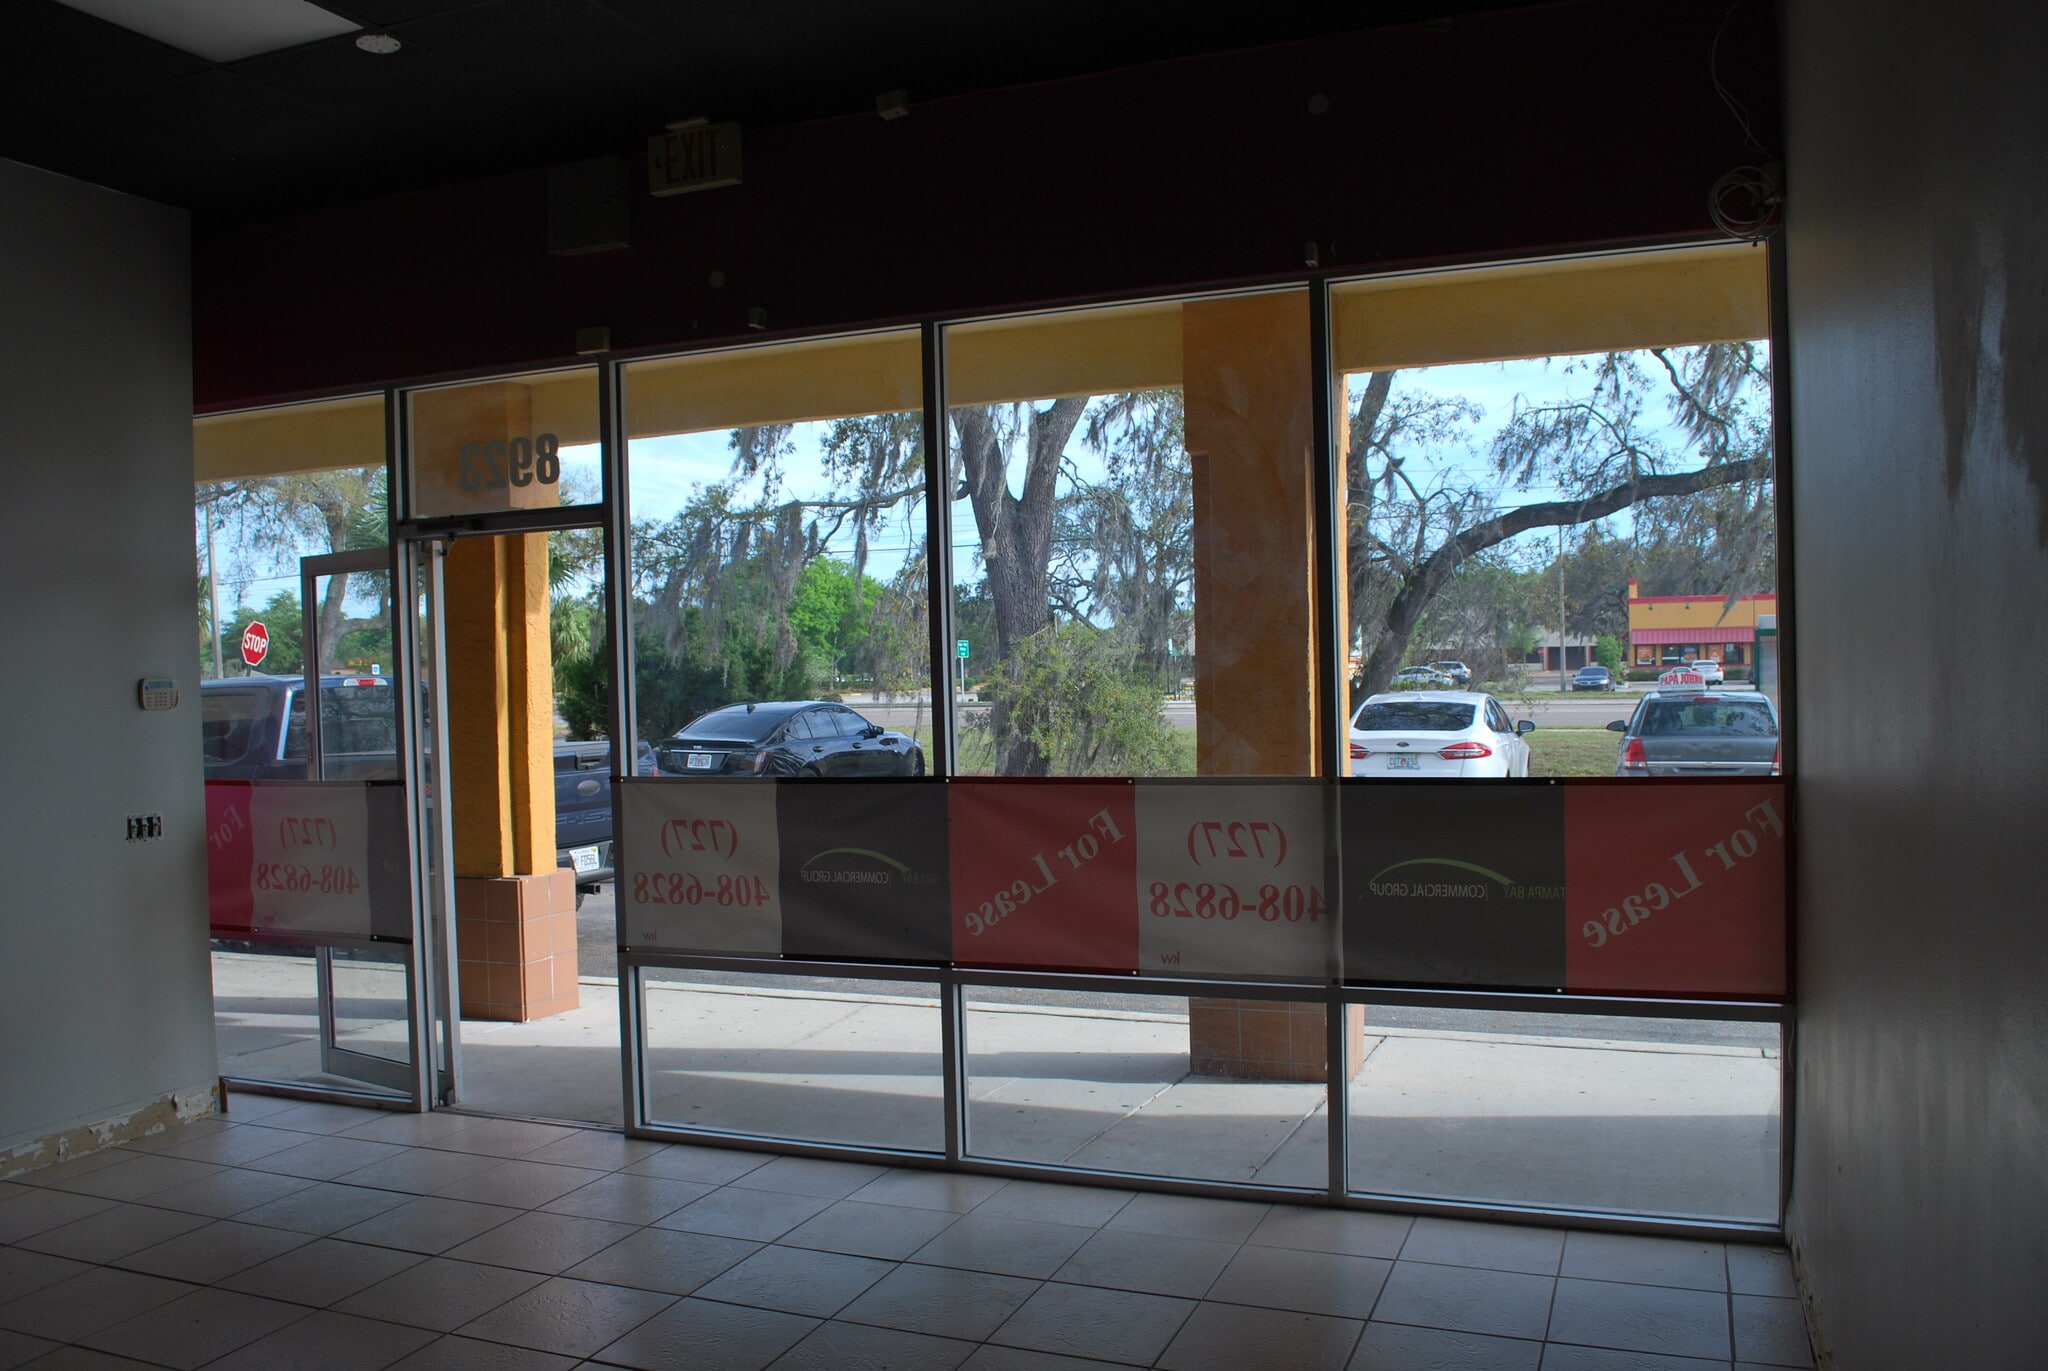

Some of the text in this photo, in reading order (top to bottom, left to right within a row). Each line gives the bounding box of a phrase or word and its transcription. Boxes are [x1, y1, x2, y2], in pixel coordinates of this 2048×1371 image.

[665, 128, 718, 185] EXIT
[244, 632, 267, 654] STOP
[1661, 674, 1679, 685] PAPA
